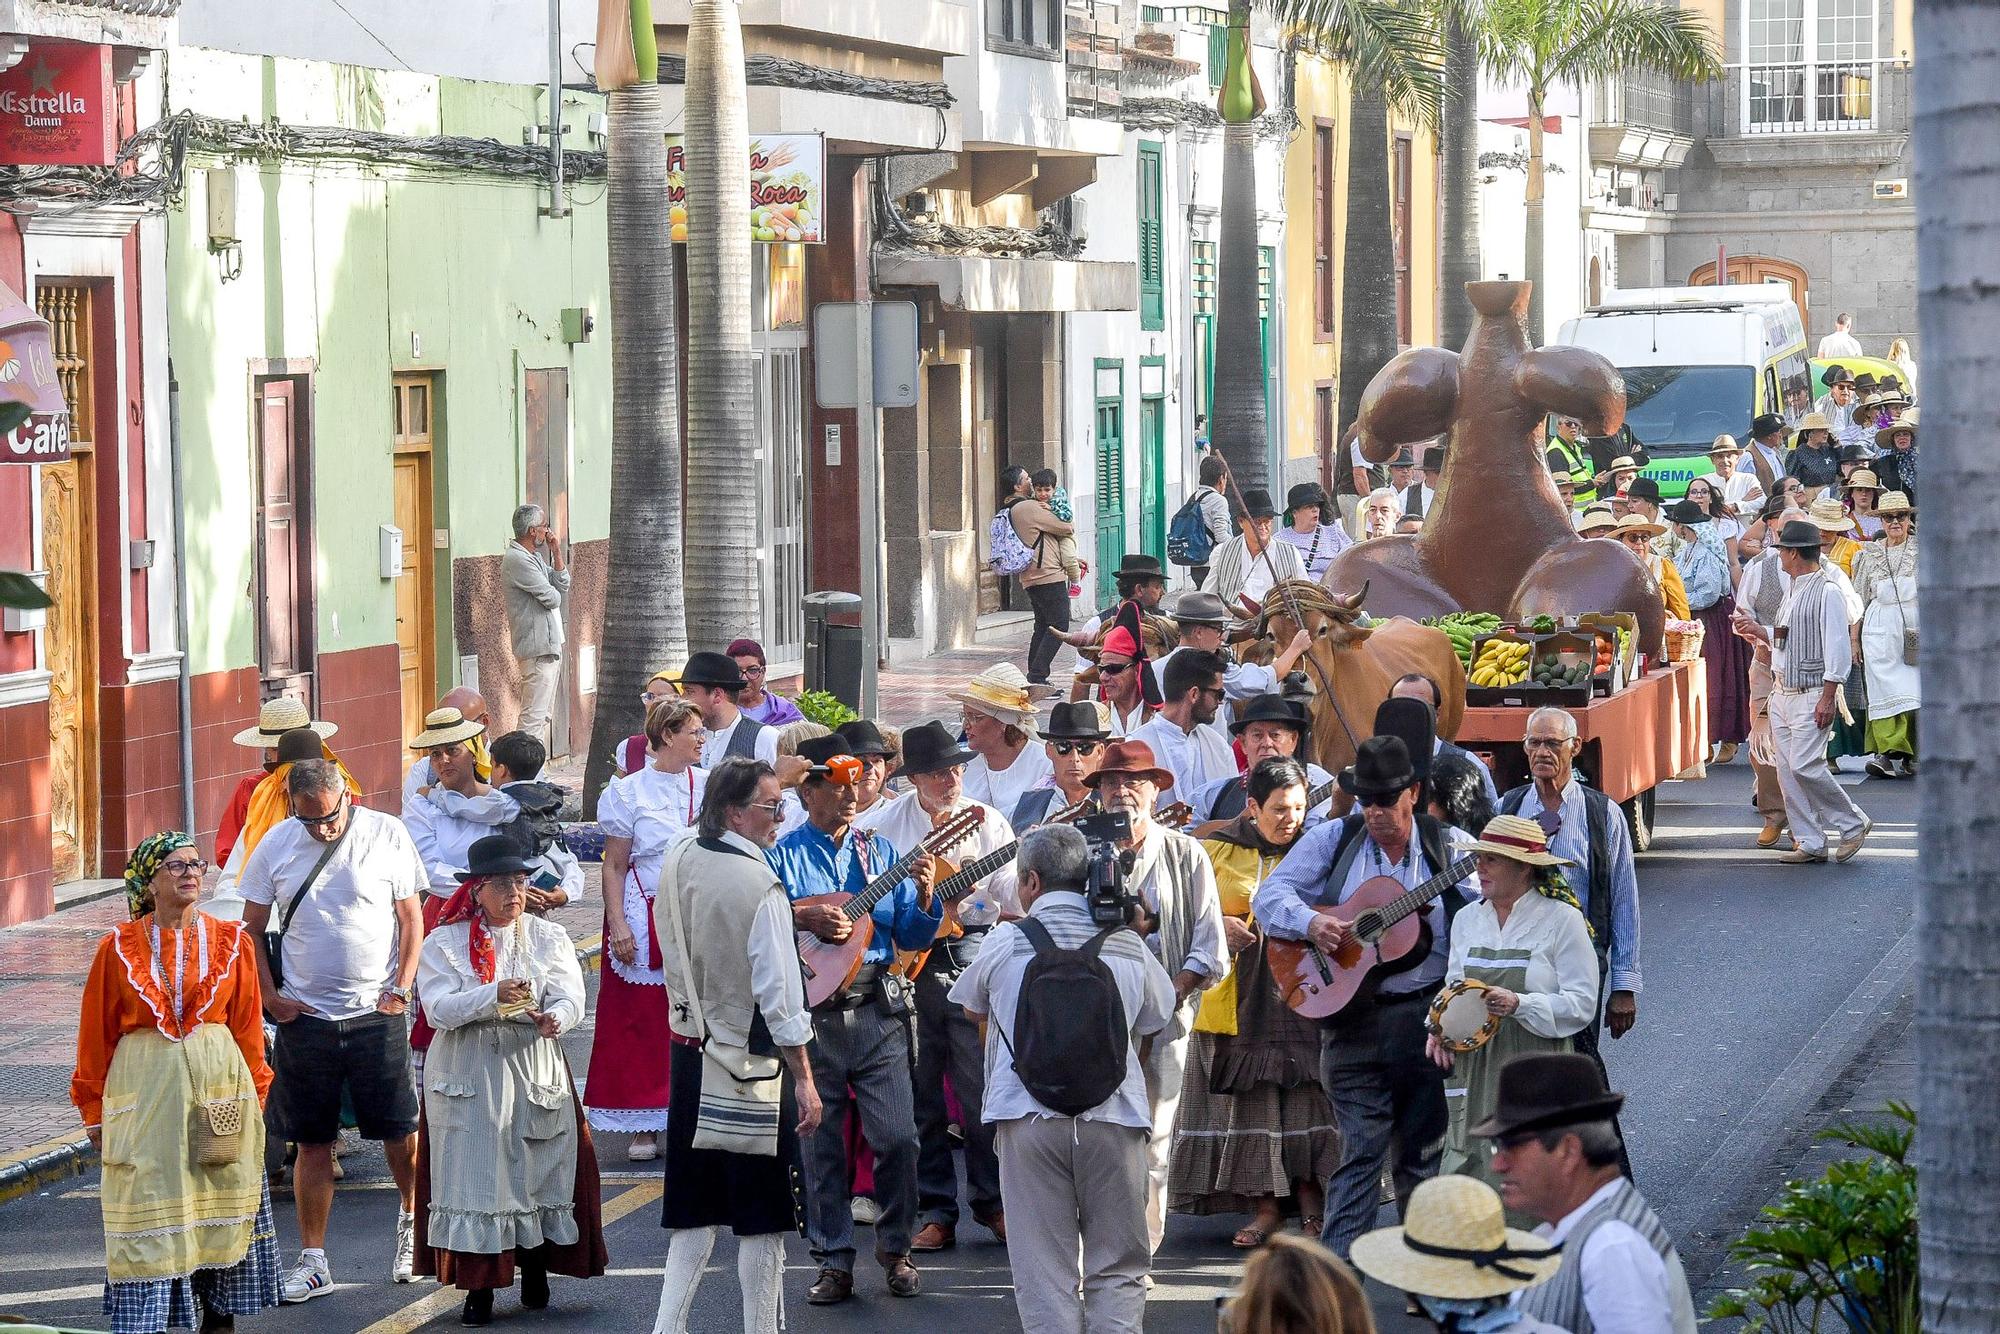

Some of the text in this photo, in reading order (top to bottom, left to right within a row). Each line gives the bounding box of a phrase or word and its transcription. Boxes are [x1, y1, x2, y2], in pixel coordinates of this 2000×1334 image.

[0, 90, 86, 114] Estrella
[24, 114, 62, 127] Damm
[8, 413, 68, 455] Café
